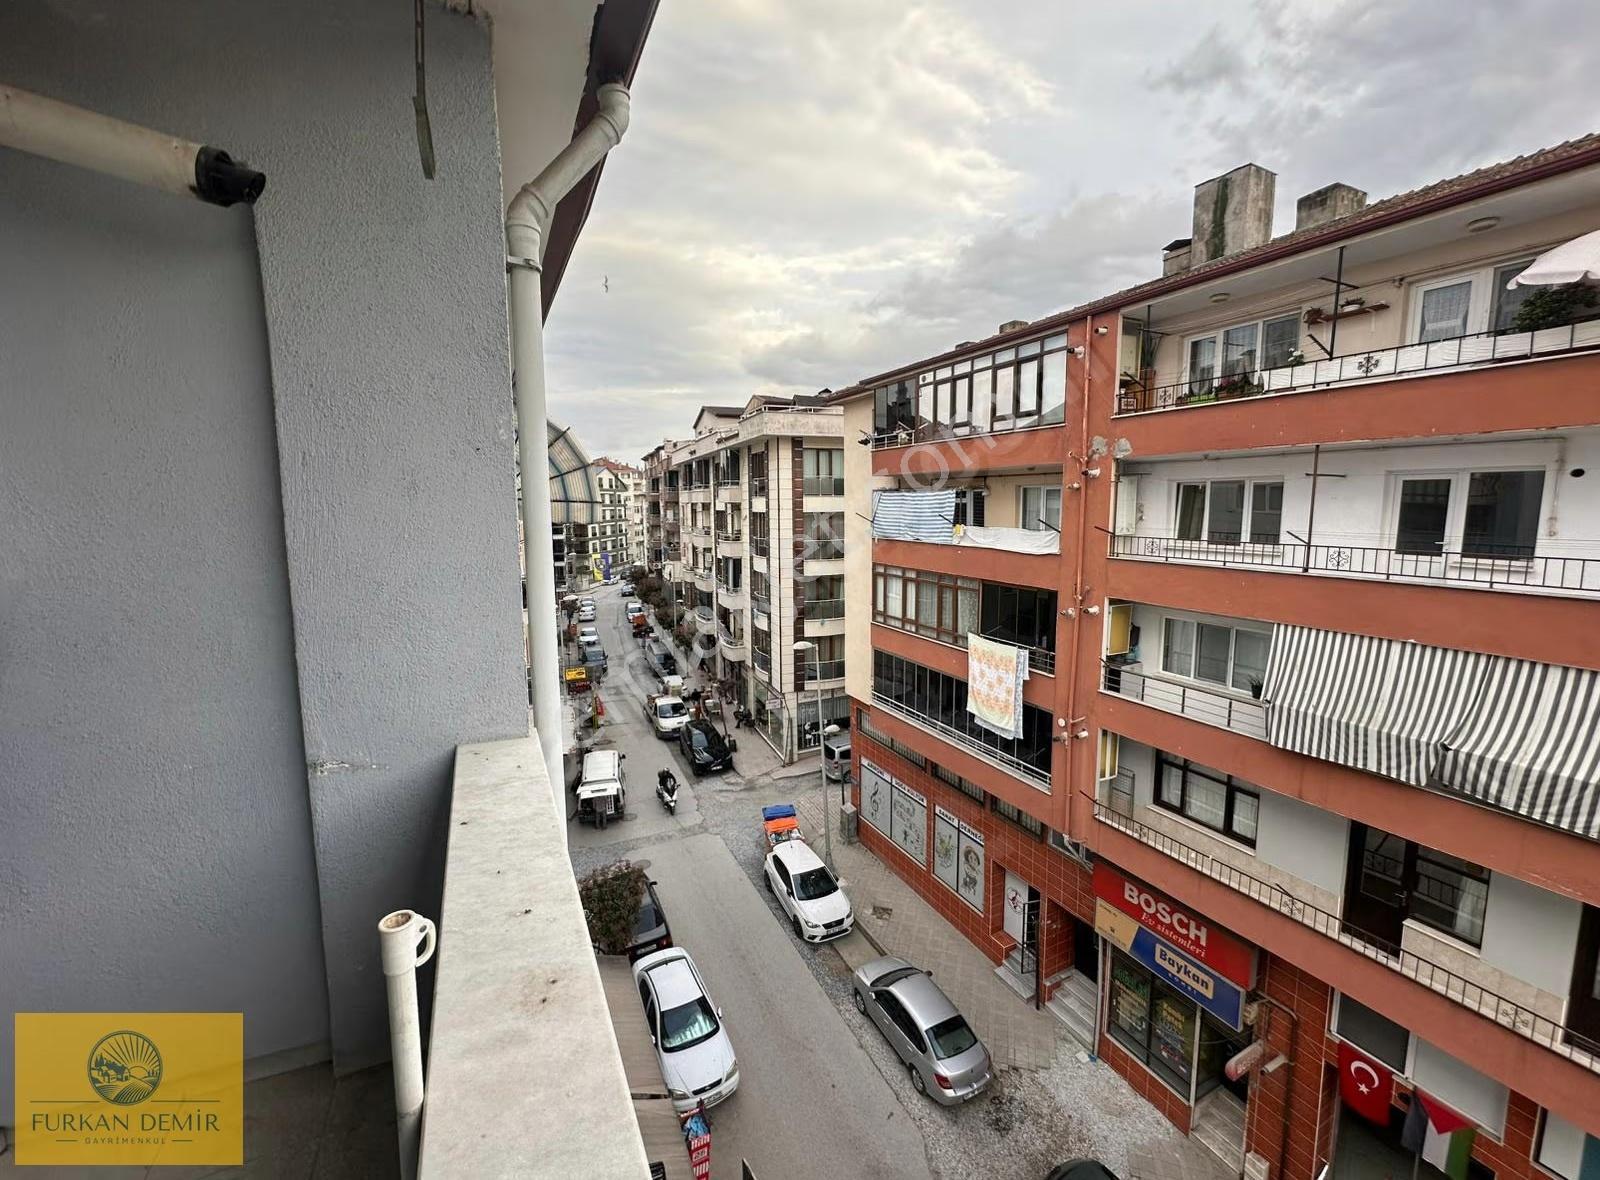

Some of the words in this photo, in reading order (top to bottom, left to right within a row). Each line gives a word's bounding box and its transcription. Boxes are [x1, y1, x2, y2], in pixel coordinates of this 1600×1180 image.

[1124, 881, 1207, 947] BOSCH
[1141, 912, 1156, 927] Ev
[1156, 924, 1207, 958] sistemleri
[1159, 948, 1209, 990] Baykan
